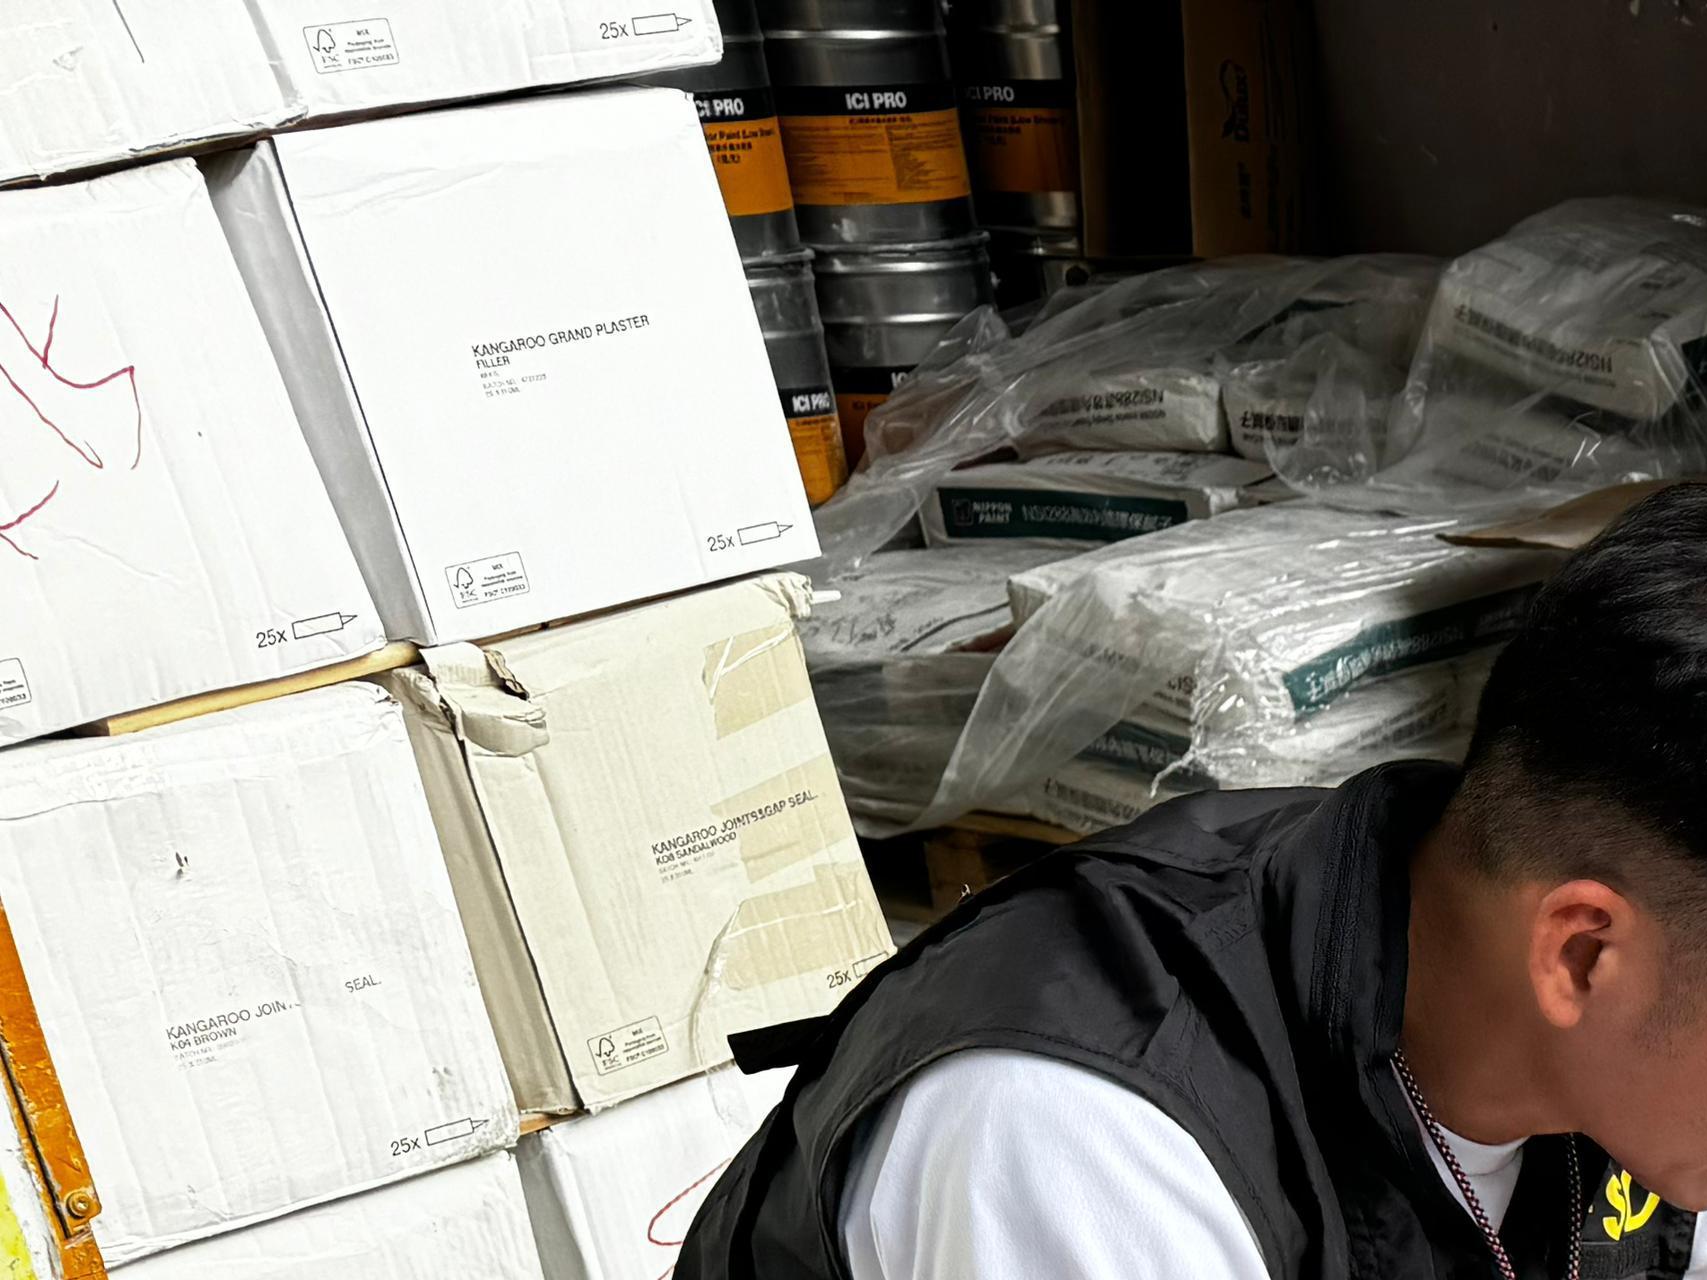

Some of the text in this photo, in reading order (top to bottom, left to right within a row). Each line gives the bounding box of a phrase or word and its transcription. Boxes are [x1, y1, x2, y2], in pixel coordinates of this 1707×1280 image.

[600, 22, 629, 39] 25x
[714, 98, 745, 117] PRO
[845, 92, 907, 110] ICI PRO
[471, 313, 651, 357] KANGAROO GRAND PLASTER
[476, 355, 511, 370] FILLER
[707, 534, 735, 552] 25x
[256, 626, 288, 648] 25x
[652, 825, 717, 855] KANGAROO
[826, 969, 852, 989] 25x
[166, 1009, 251, 1041] KANGAROO
[194, 1027, 237, 1047] BROWN
[391, 1137, 421, 1157] 25x
